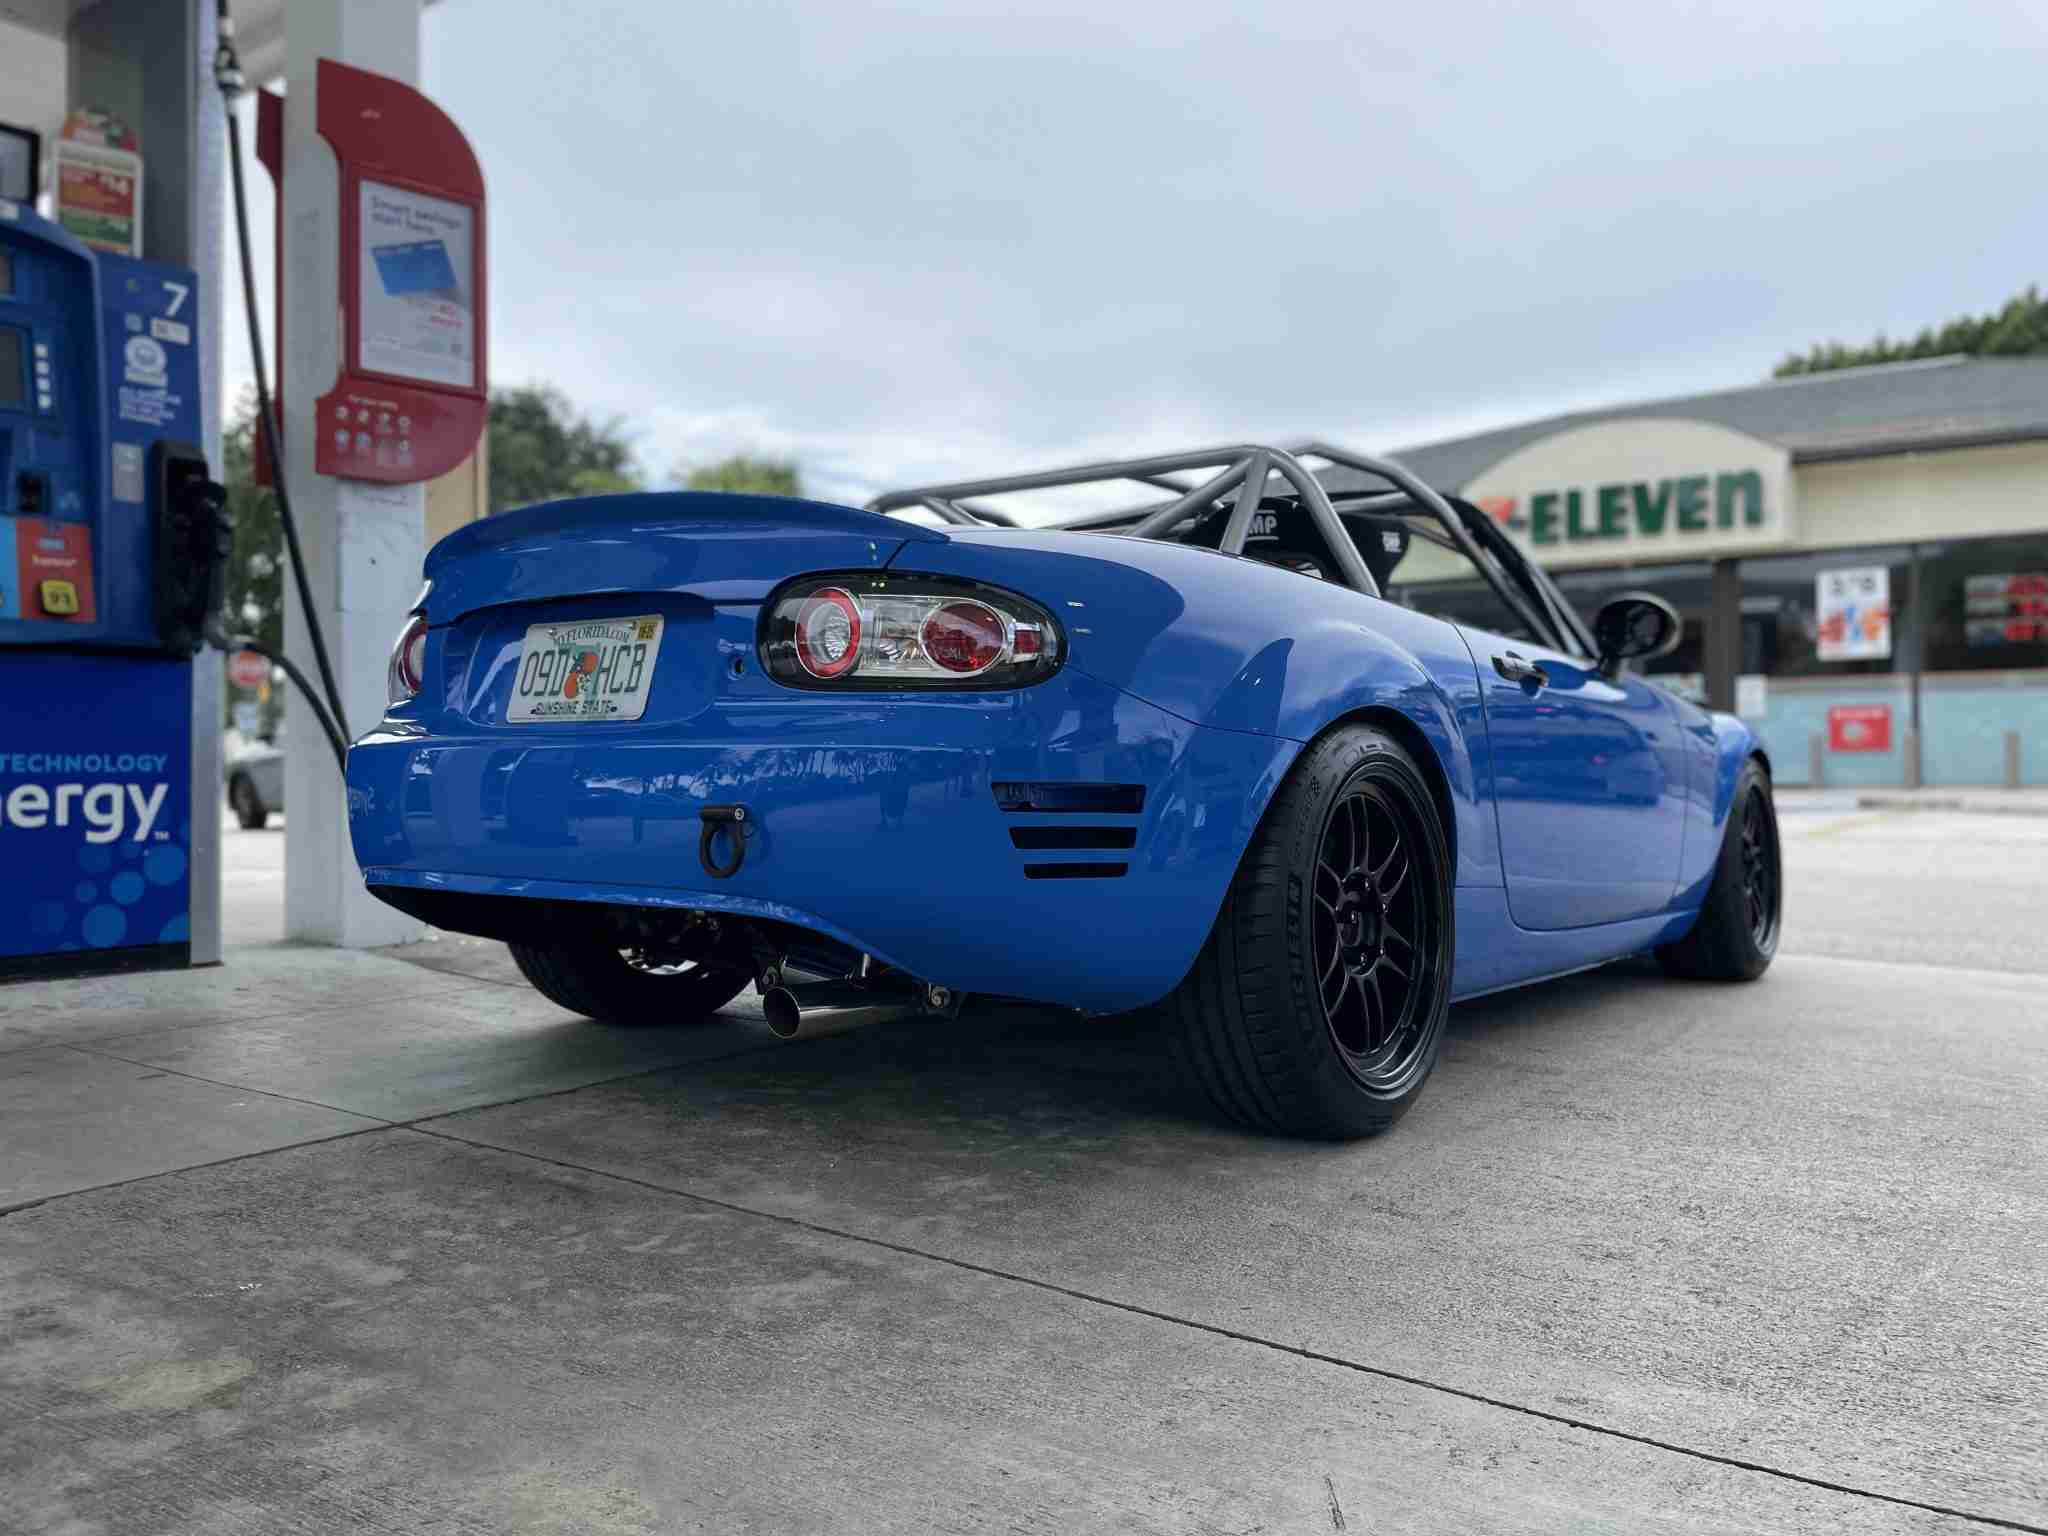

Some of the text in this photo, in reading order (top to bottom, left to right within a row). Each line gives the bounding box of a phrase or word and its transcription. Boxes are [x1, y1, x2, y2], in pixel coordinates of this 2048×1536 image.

[163, 281, 189, 316] 7
[1247, 515, 1277, 534] MP
[0, 754, 168, 773] TECHNOLOGY
[0, 783, 169, 843] ergy
